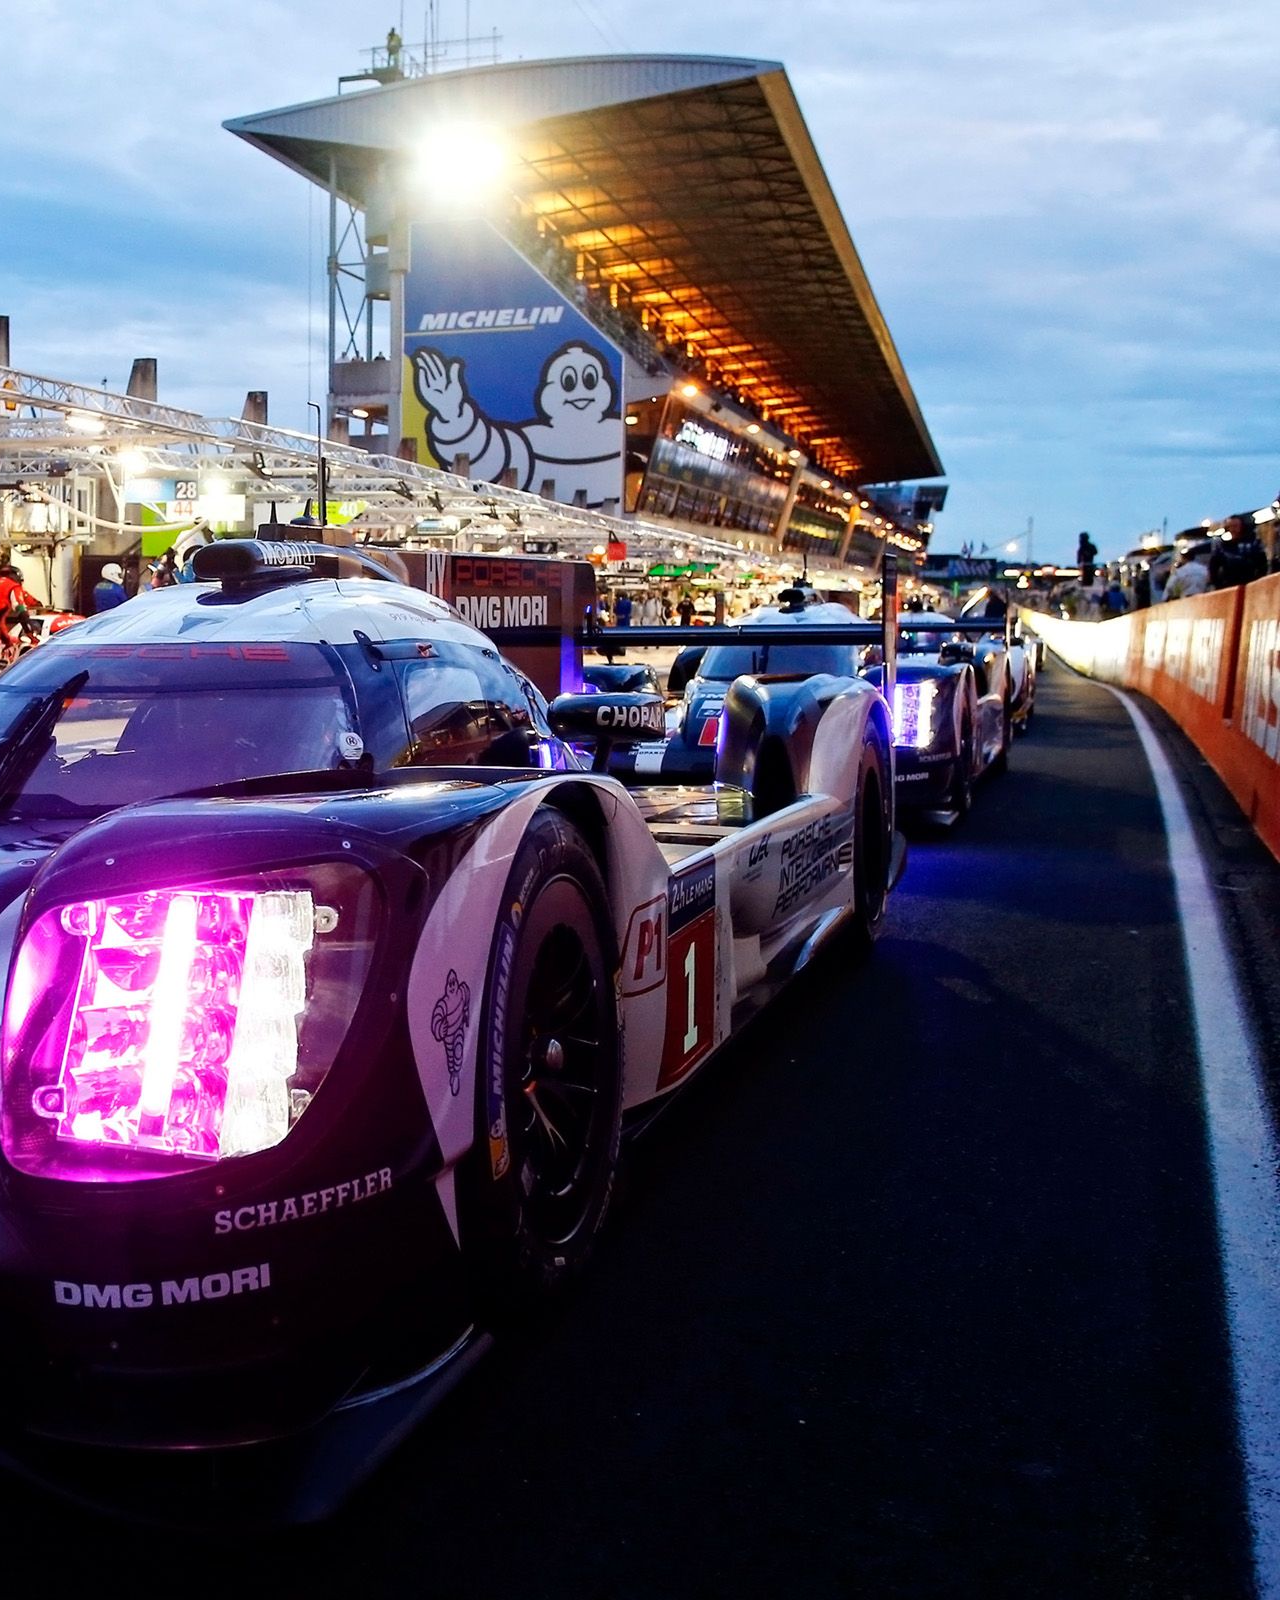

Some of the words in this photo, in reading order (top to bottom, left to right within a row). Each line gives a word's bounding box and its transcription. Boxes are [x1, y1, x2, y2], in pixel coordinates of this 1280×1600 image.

[419, 306, 564, 331] MICHELIN
[175, 482, 197, 499] 28
[255, 541, 303, 565] Mobil
[426, 553, 446, 599] HY
[456, 595, 501, 629] DMG
[503, 595, 548, 628] MORI
[685, 888, 694, 904] LE
[693, 873, 713, 898] MANS
[633, 911, 663, 981] P1
[493, 932, 514, 1095] MICHELIN
[683, 941, 698, 1055] 1
[214, 1167, 393, 1235] SCHAEFFLER
[54, 1280, 154, 1309] DMG
[161, 1263, 271, 1306] MORI
